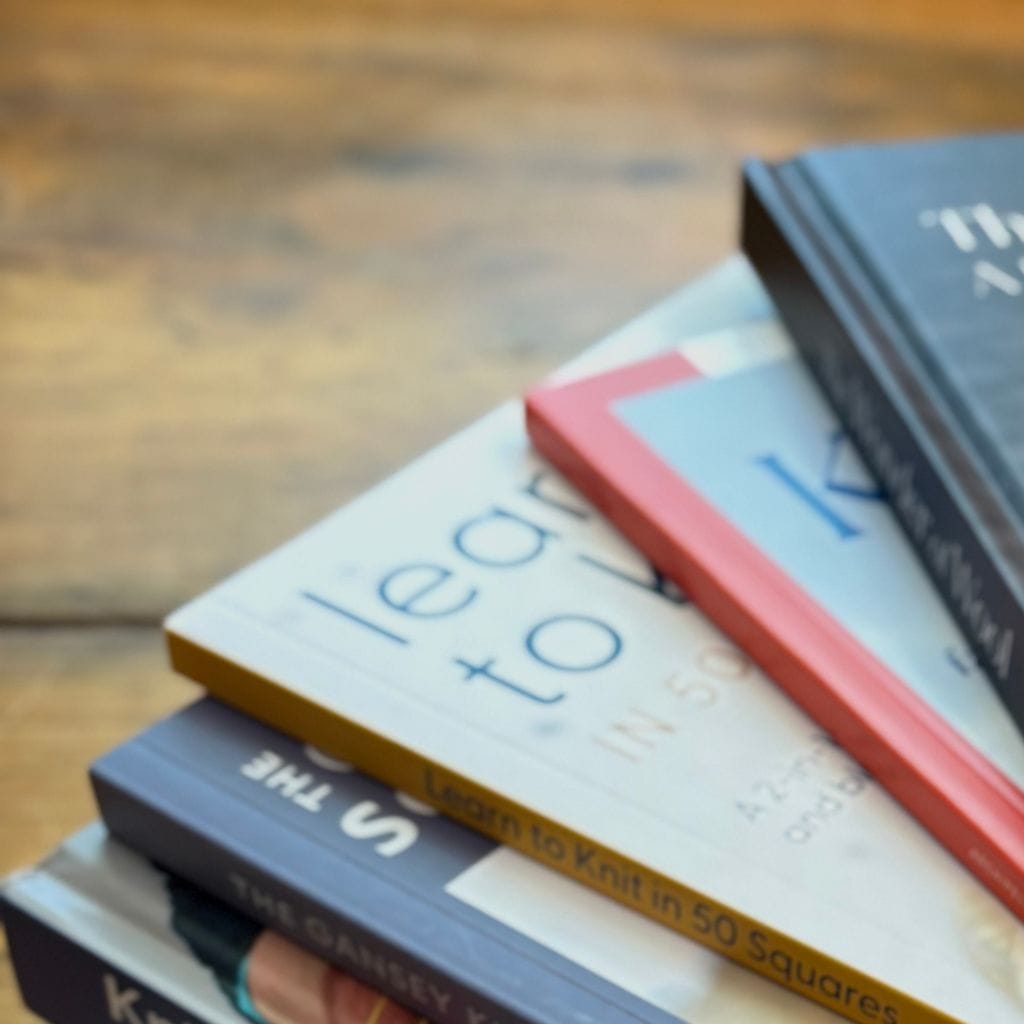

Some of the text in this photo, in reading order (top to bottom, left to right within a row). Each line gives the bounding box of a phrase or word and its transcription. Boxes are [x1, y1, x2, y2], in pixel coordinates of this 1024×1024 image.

[301, 467, 588, 647] lear
[453, 613, 623, 705] to
[228, 871, 297, 920] THE
[303, 916, 452, 1016] GANSEY
[530, 821, 566, 861] to
[574, 838, 645, 898] Knit
[651, 881, 683, 920] in
[692, 902, 739, 948] 50
